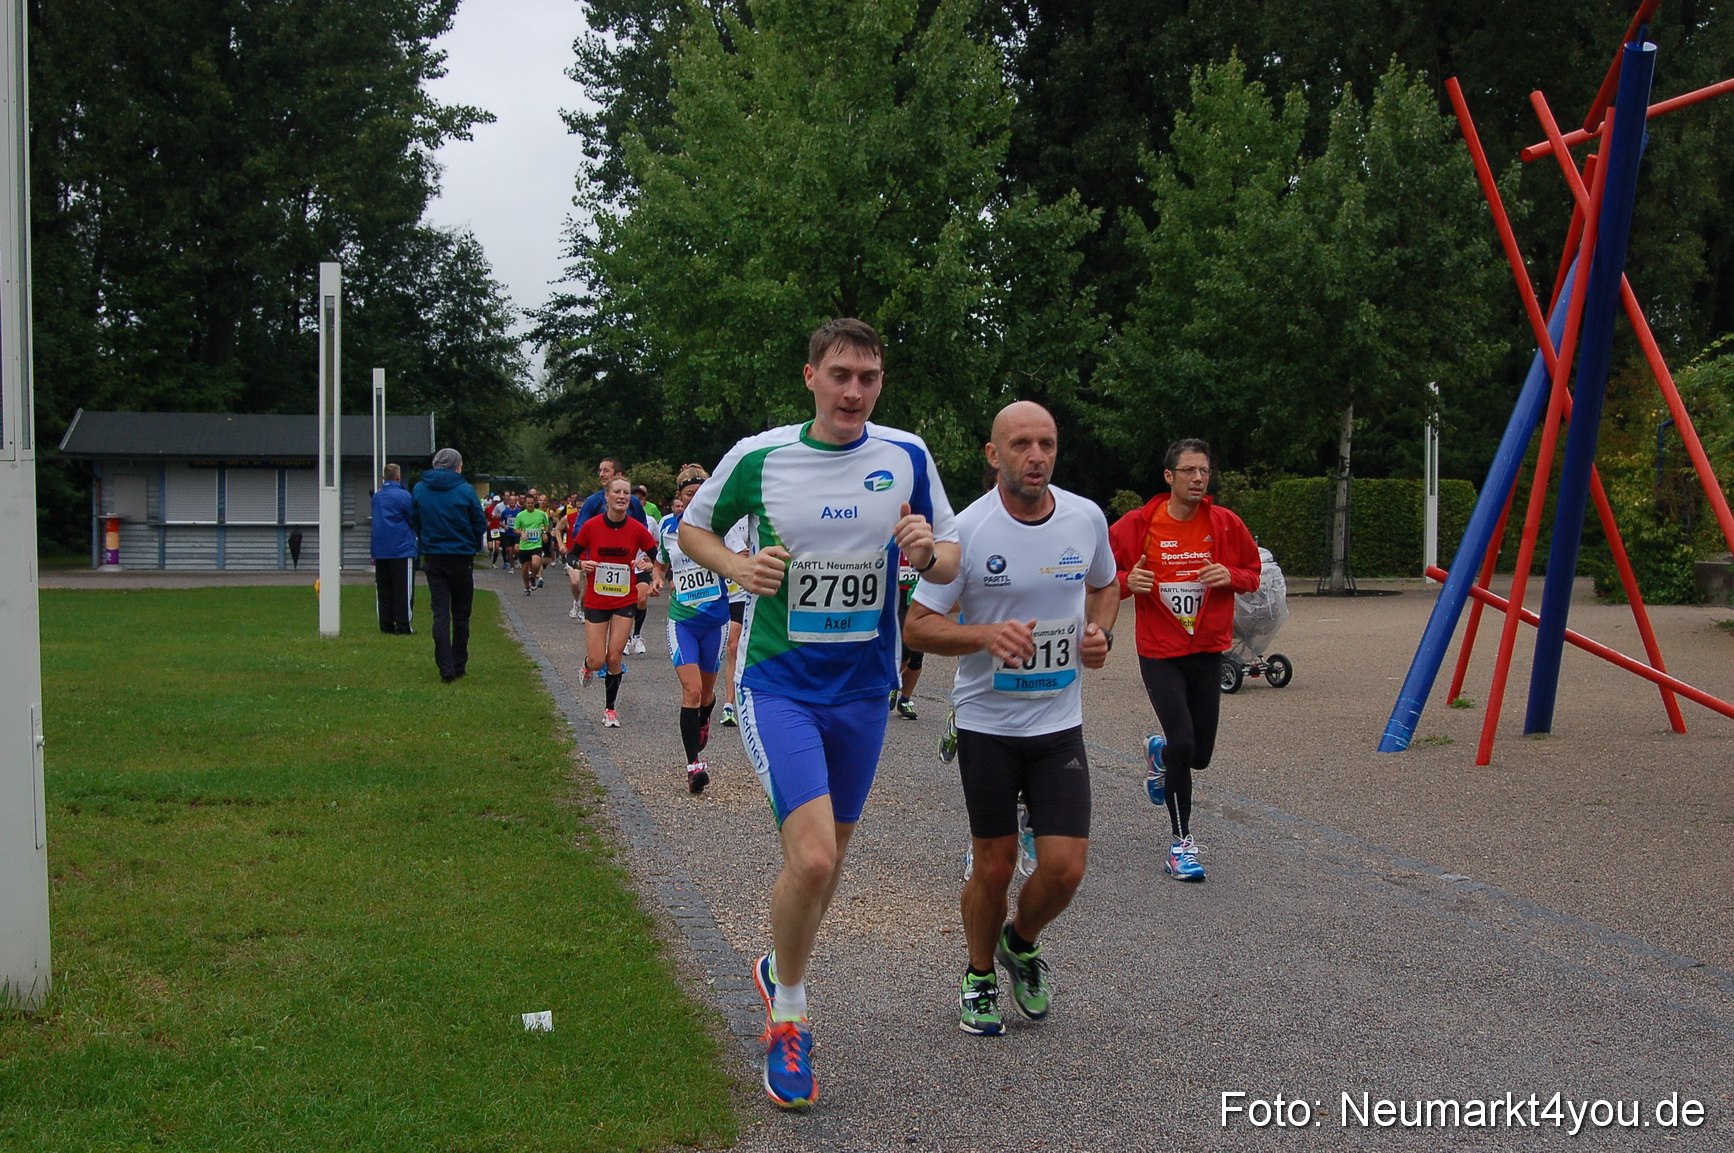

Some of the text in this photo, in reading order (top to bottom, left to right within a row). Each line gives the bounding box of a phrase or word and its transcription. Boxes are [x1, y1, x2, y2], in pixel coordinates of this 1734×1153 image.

[820, 505, 858, 519] Axel
[1161, 550, 1212, 561] SportScheck
[791, 561, 872, 571] PARTL Neumarkt
[605, 570, 620, 584] 31
[679, 570, 715, 592] 2804
[983, 575, 1011, 583] PARTL
[798, 573, 878, 607] 2799
[1171, 595, 1202, 615] 301
[824, 616, 851, 630] Axel
[1030, 627, 1066, 638] eumarkt
[1015, 677, 1059, 690] Thomas
